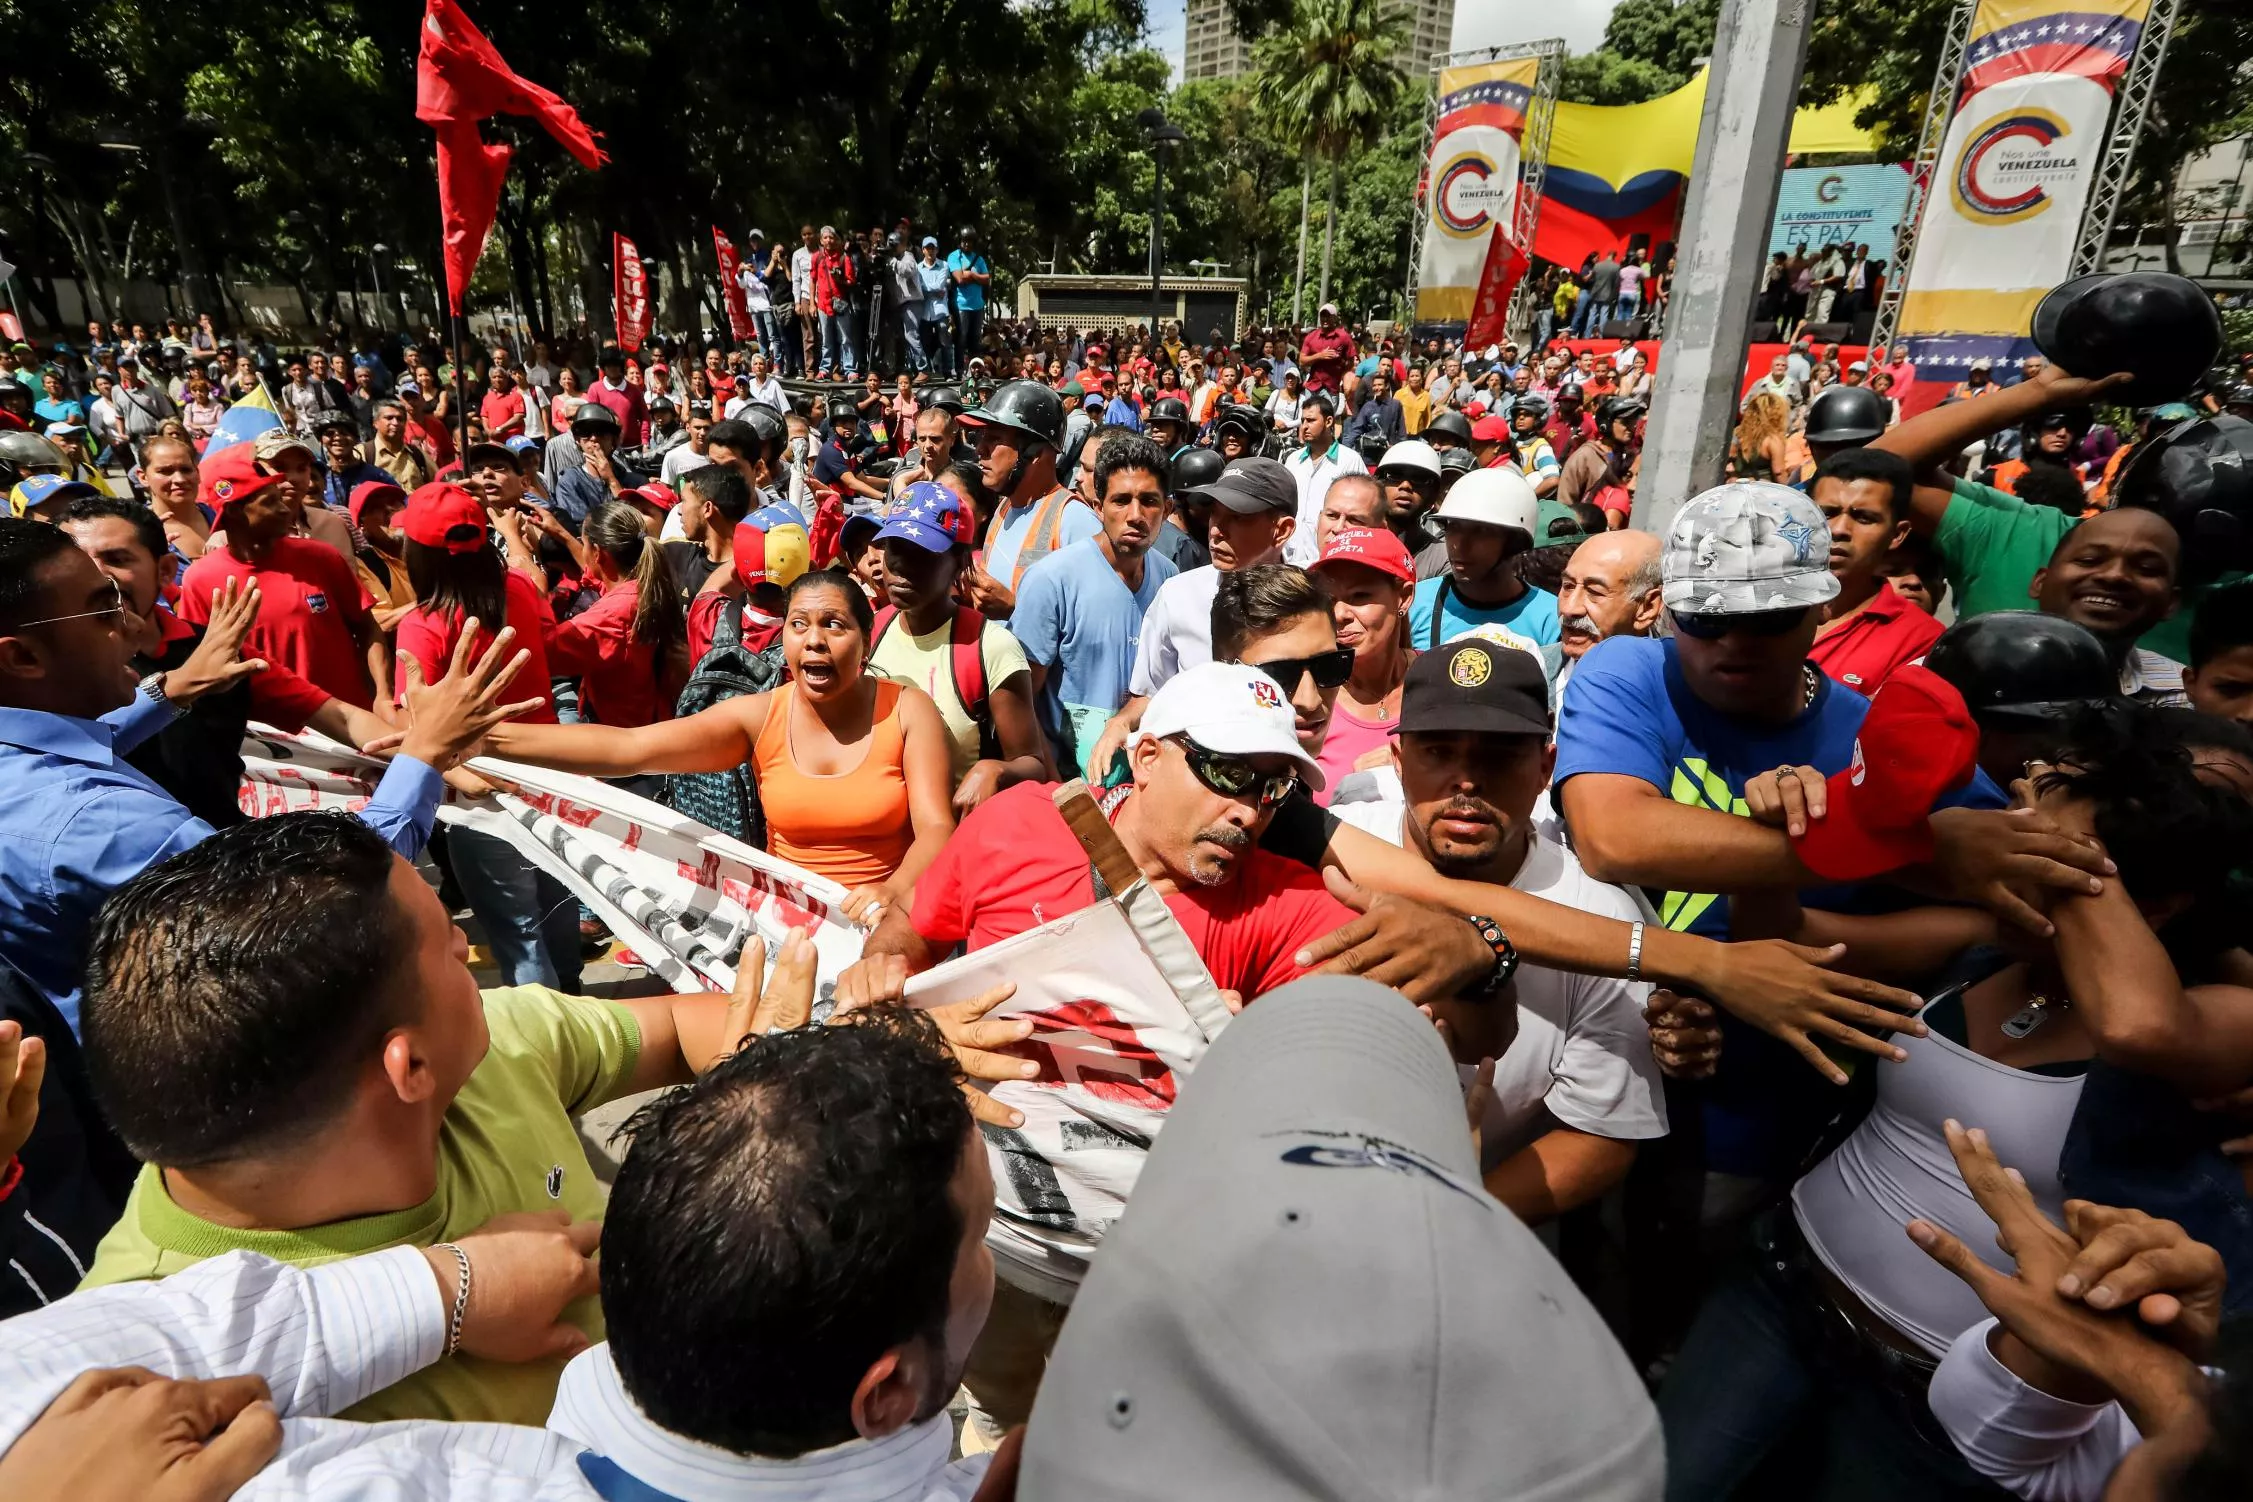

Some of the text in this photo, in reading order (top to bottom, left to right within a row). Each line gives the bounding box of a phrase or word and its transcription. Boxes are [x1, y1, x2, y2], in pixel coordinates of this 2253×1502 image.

[2001, 150, 2050, 159] Nos une
[1999, 159, 2077, 171] VENEZUELA
[1460, 190, 1504, 198] VENEZUELA
[1781, 210, 1873, 221] LA CONSTITUYENTE
[1787, 224, 1859, 245] ES PAZ
[1328, 531, 1373, 544] VENEZUELA
[1326, 545, 1364, 559] RESPETA
